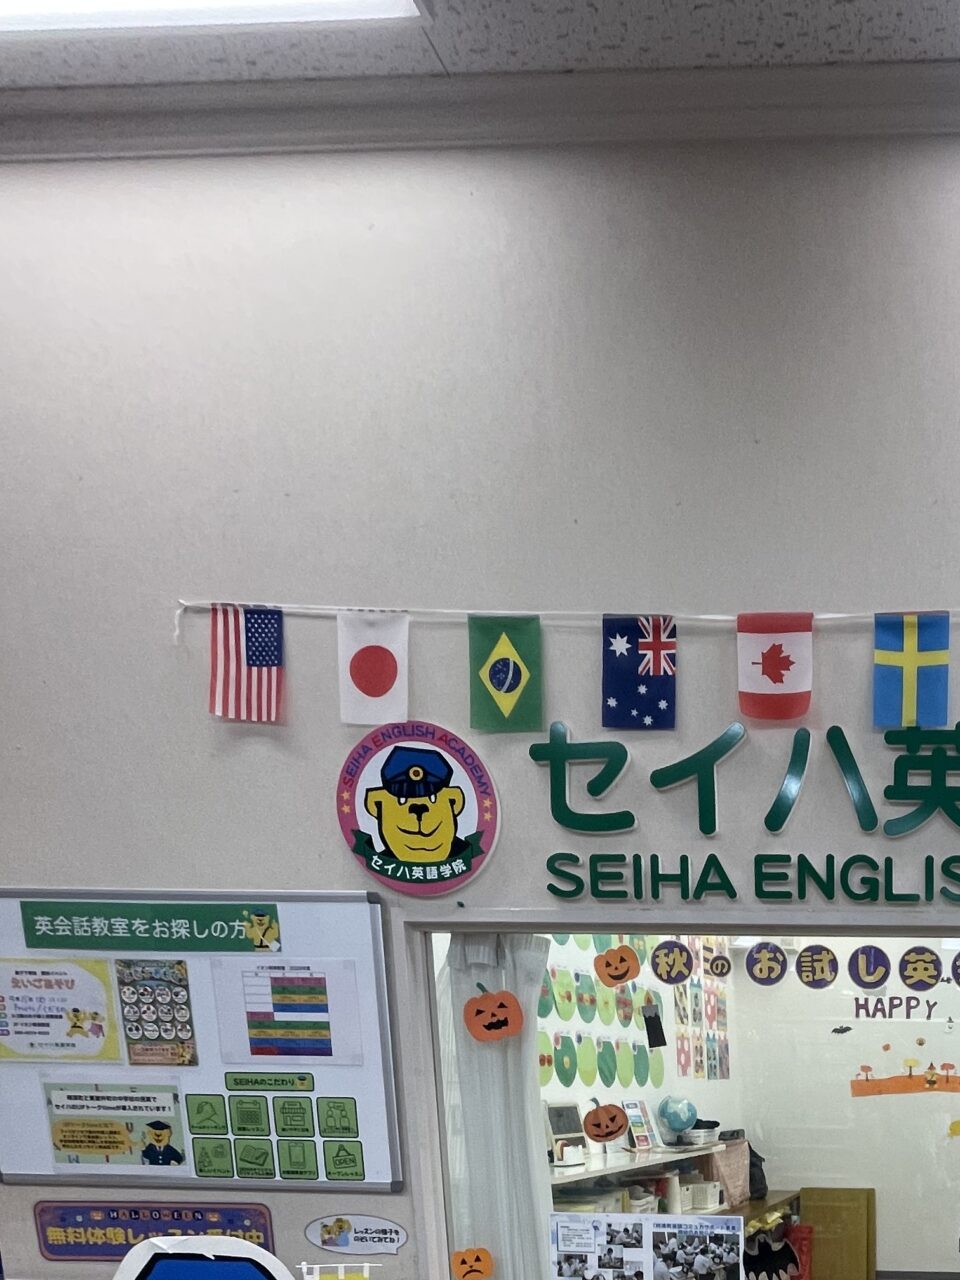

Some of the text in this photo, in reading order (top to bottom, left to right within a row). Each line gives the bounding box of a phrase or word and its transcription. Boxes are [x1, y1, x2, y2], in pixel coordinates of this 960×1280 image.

[343, 724, 491, 797] SEIHA ENGLISH ACADEMY
[371, 855, 467, 880] セイハ英語学院
[546, 852, 737, 901] SEIHA
[853, 996, 939, 1020] HAPPY
[334, 1157, 356, 1167] OPEN
[108, 1209, 205, 1221] HALLOWEEN
